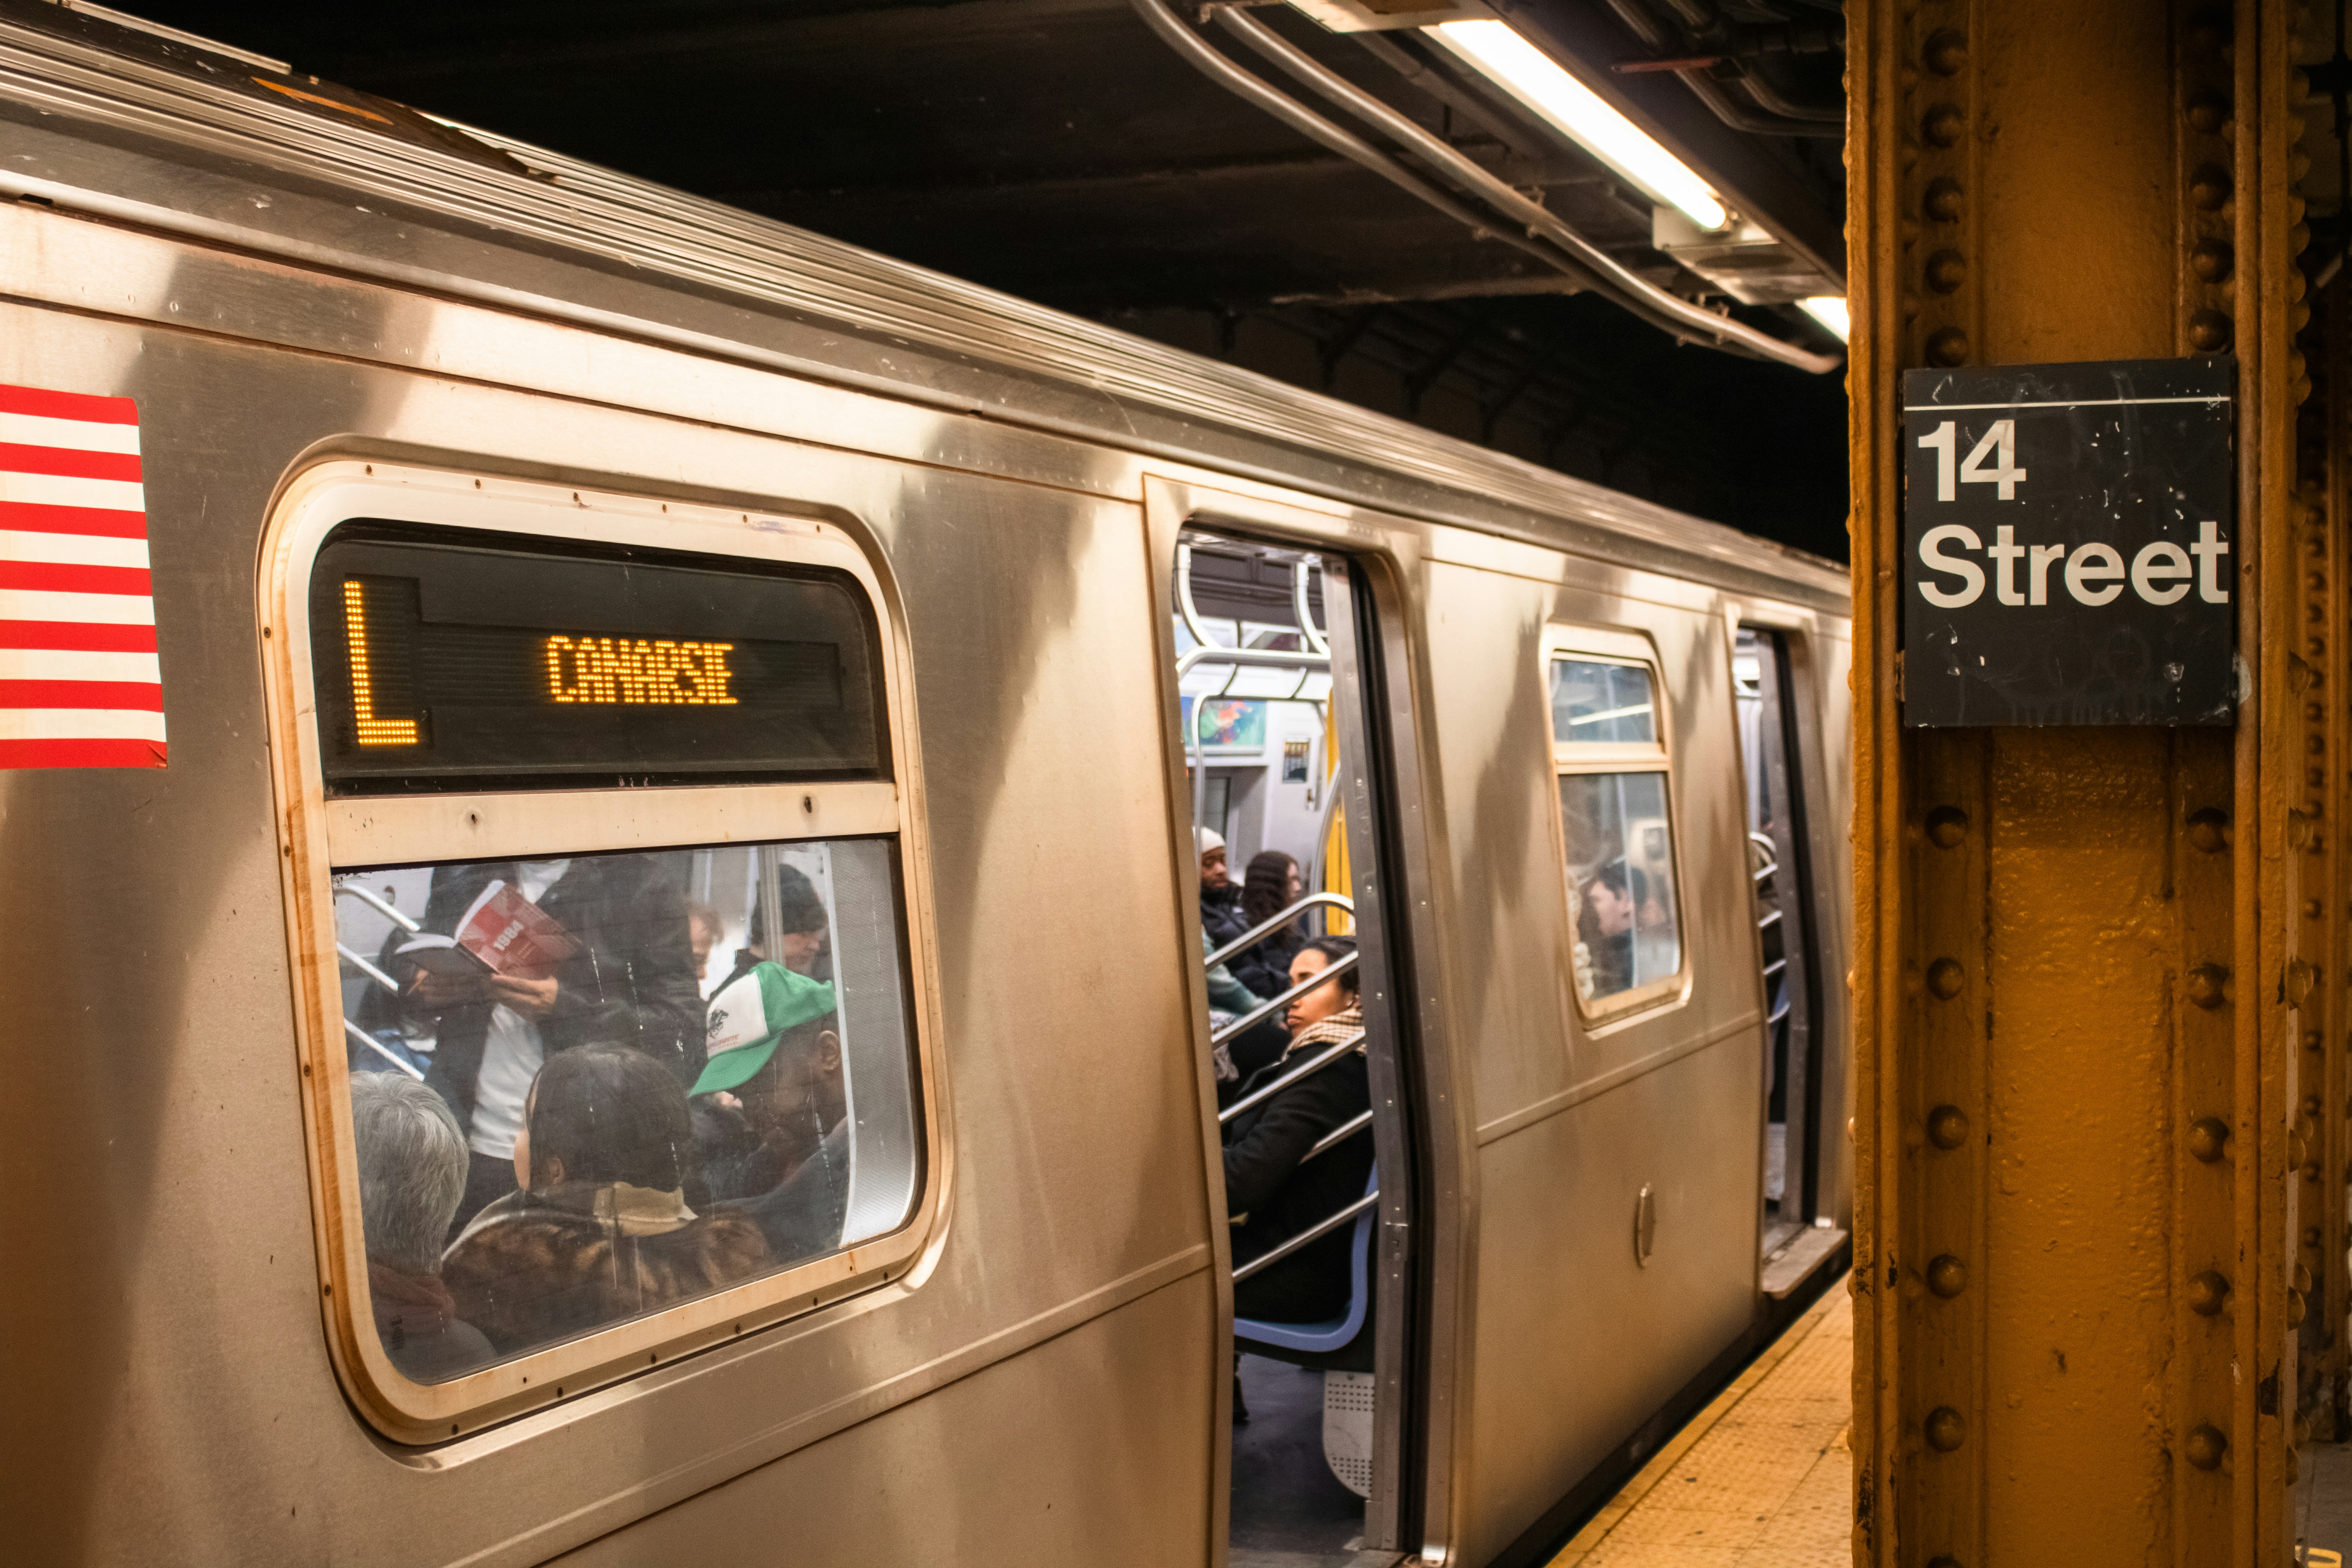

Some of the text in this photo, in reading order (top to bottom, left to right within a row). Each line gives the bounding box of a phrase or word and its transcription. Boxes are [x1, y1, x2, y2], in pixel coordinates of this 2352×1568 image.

[1918, 419, 2026, 501] 14
[1918, 521, 2229, 608] Street
[344, 580, 418, 746] L
[547, 635, 739, 705] CANARSIE
[493, 920, 525, 951] 1984
